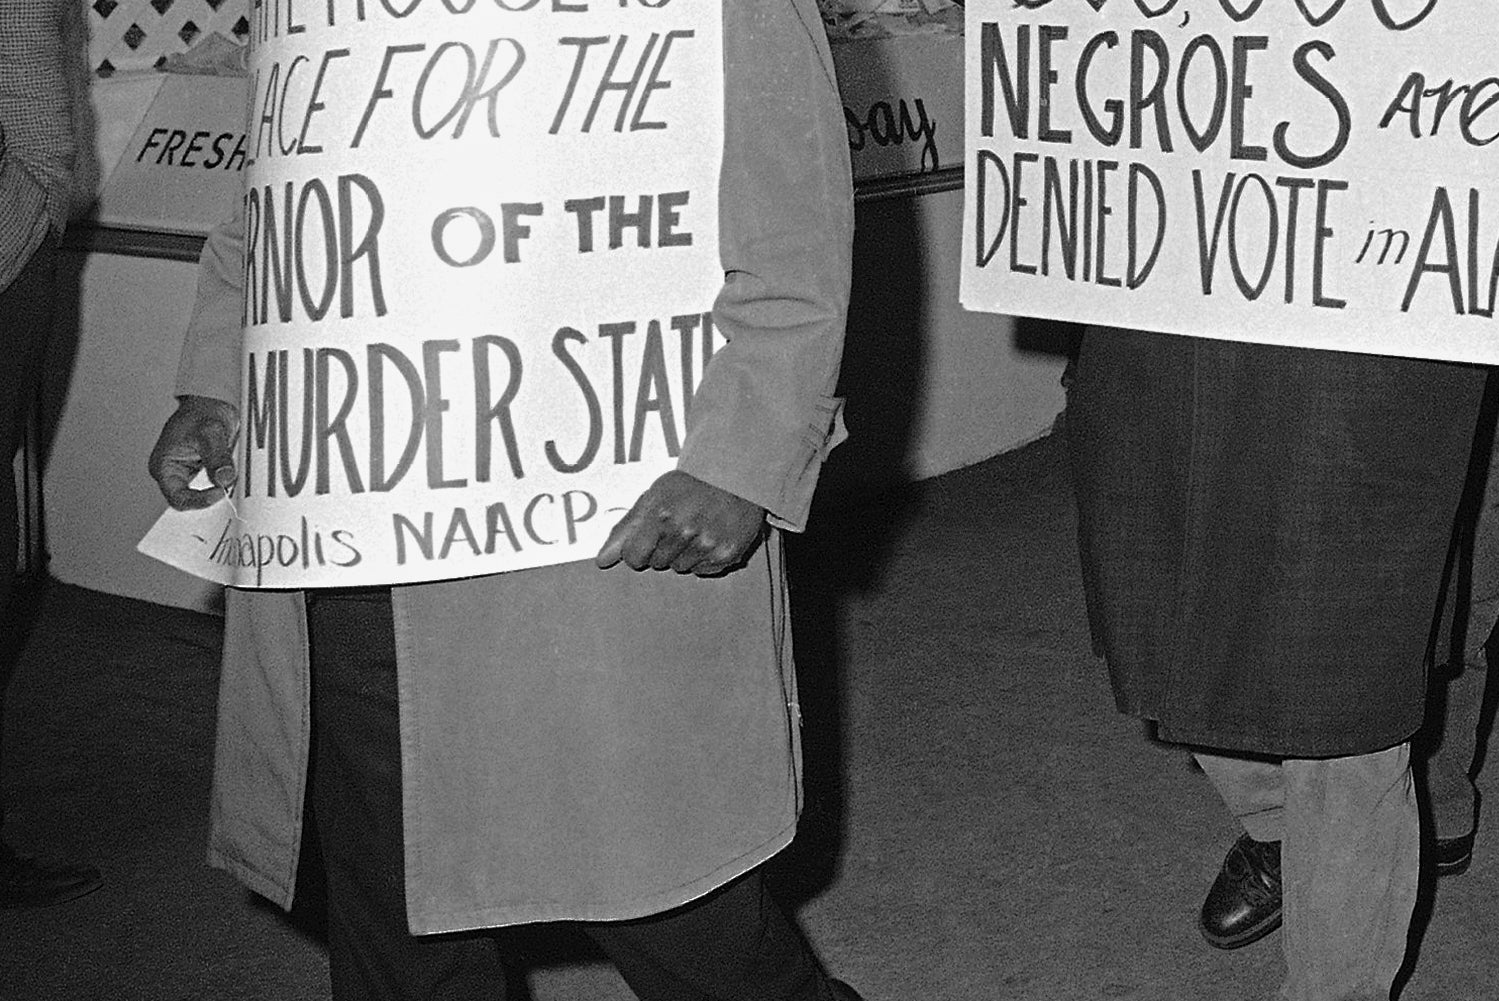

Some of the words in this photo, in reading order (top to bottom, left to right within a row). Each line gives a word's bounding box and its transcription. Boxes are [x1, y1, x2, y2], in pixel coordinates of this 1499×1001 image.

[136, 127, 247, 171] FRESH
[350, 37, 526, 149] FOR
[551, 29, 694, 135] THE
[979, 21, 1352, 169] NEGROES
[431, 202, 543, 268] OF
[565, 190, 693, 252] THE
[976, 148, 1166, 289] DENIED
[1192, 169, 1349, 309] VOTE
[1355, 219, 1409, 265] in
[244, 335, 525, 499] MURDER
